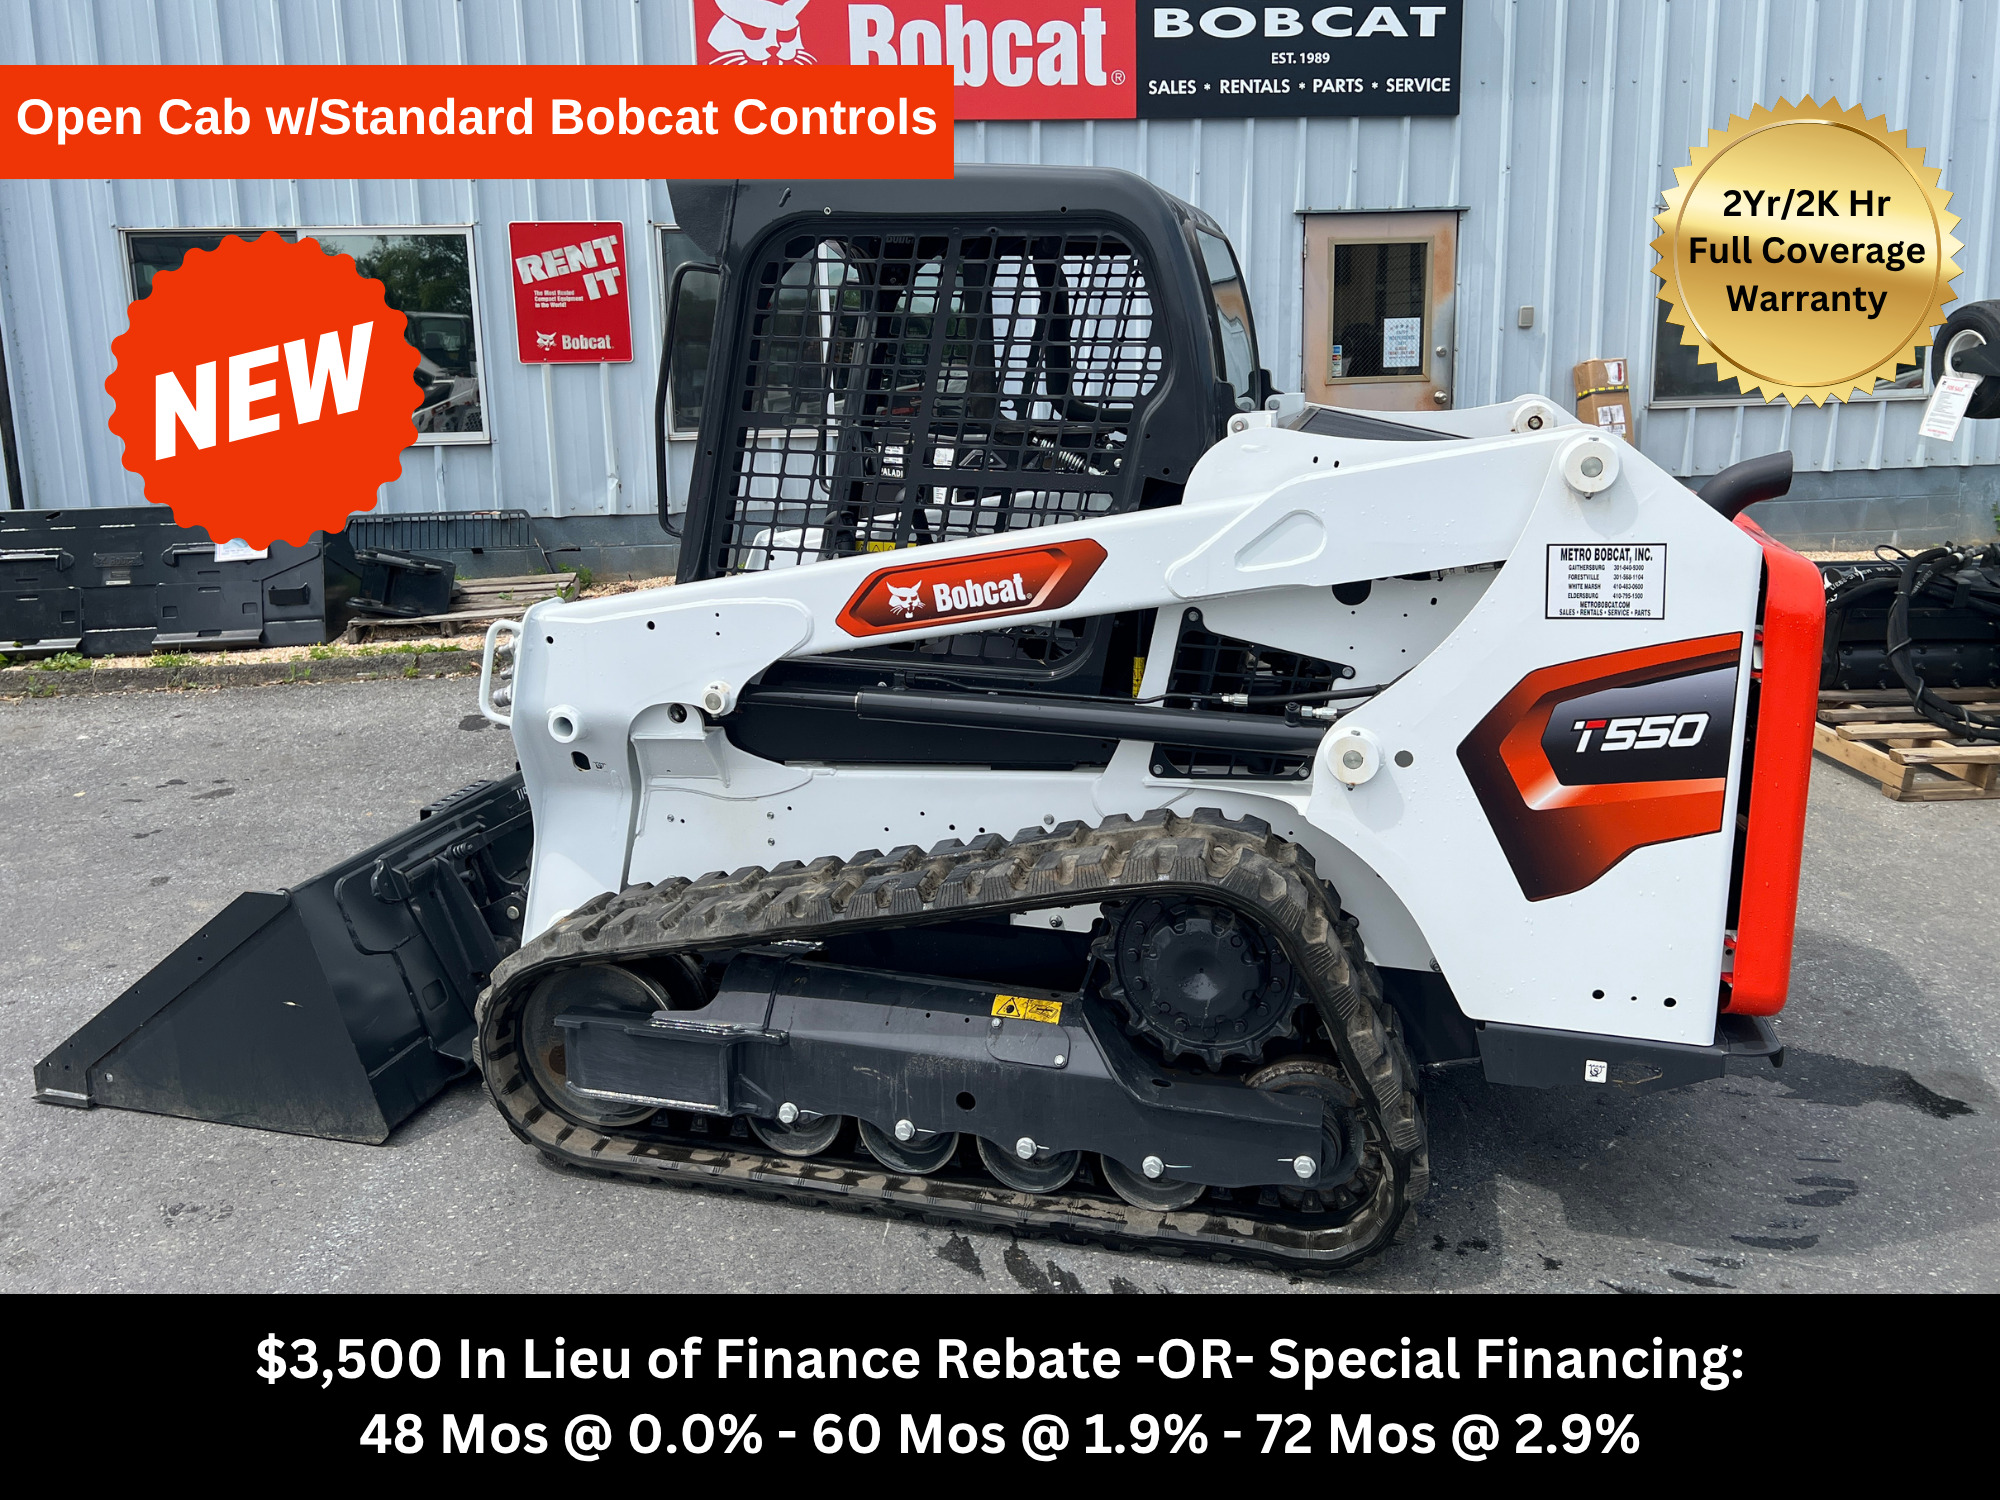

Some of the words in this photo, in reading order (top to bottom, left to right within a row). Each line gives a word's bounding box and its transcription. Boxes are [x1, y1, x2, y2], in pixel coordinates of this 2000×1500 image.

[1153, 6, 1447, 38] BOBCAT
[848, 4, 1107, 87] Bobcat
[1270, 52, 1296, 64] EST.
[1299, 52, 1330, 64] 1989
[1148, 80, 1197, 95] SALES
[1219, 79, 1291, 94] RENTALS
[1312, 78, 1364, 93] PARTS
[1386, 77, 1450, 93] SERVICE
[516, 234, 618, 285] RENT
[582, 266, 620, 301] IT
[562, 334, 612, 350] Bobcat
[881, 467, 904, 478] ALADI
[1560, 547, 1592, 562] METRO
[1594, 547, 1632, 563] BOBCAT,
[1635, 547, 1653, 562] INC.
[932, 573, 1027, 613] Bobcat
[1559, 608, 1576, 616] SALES
[1573, 713, 1709, 753] T550
